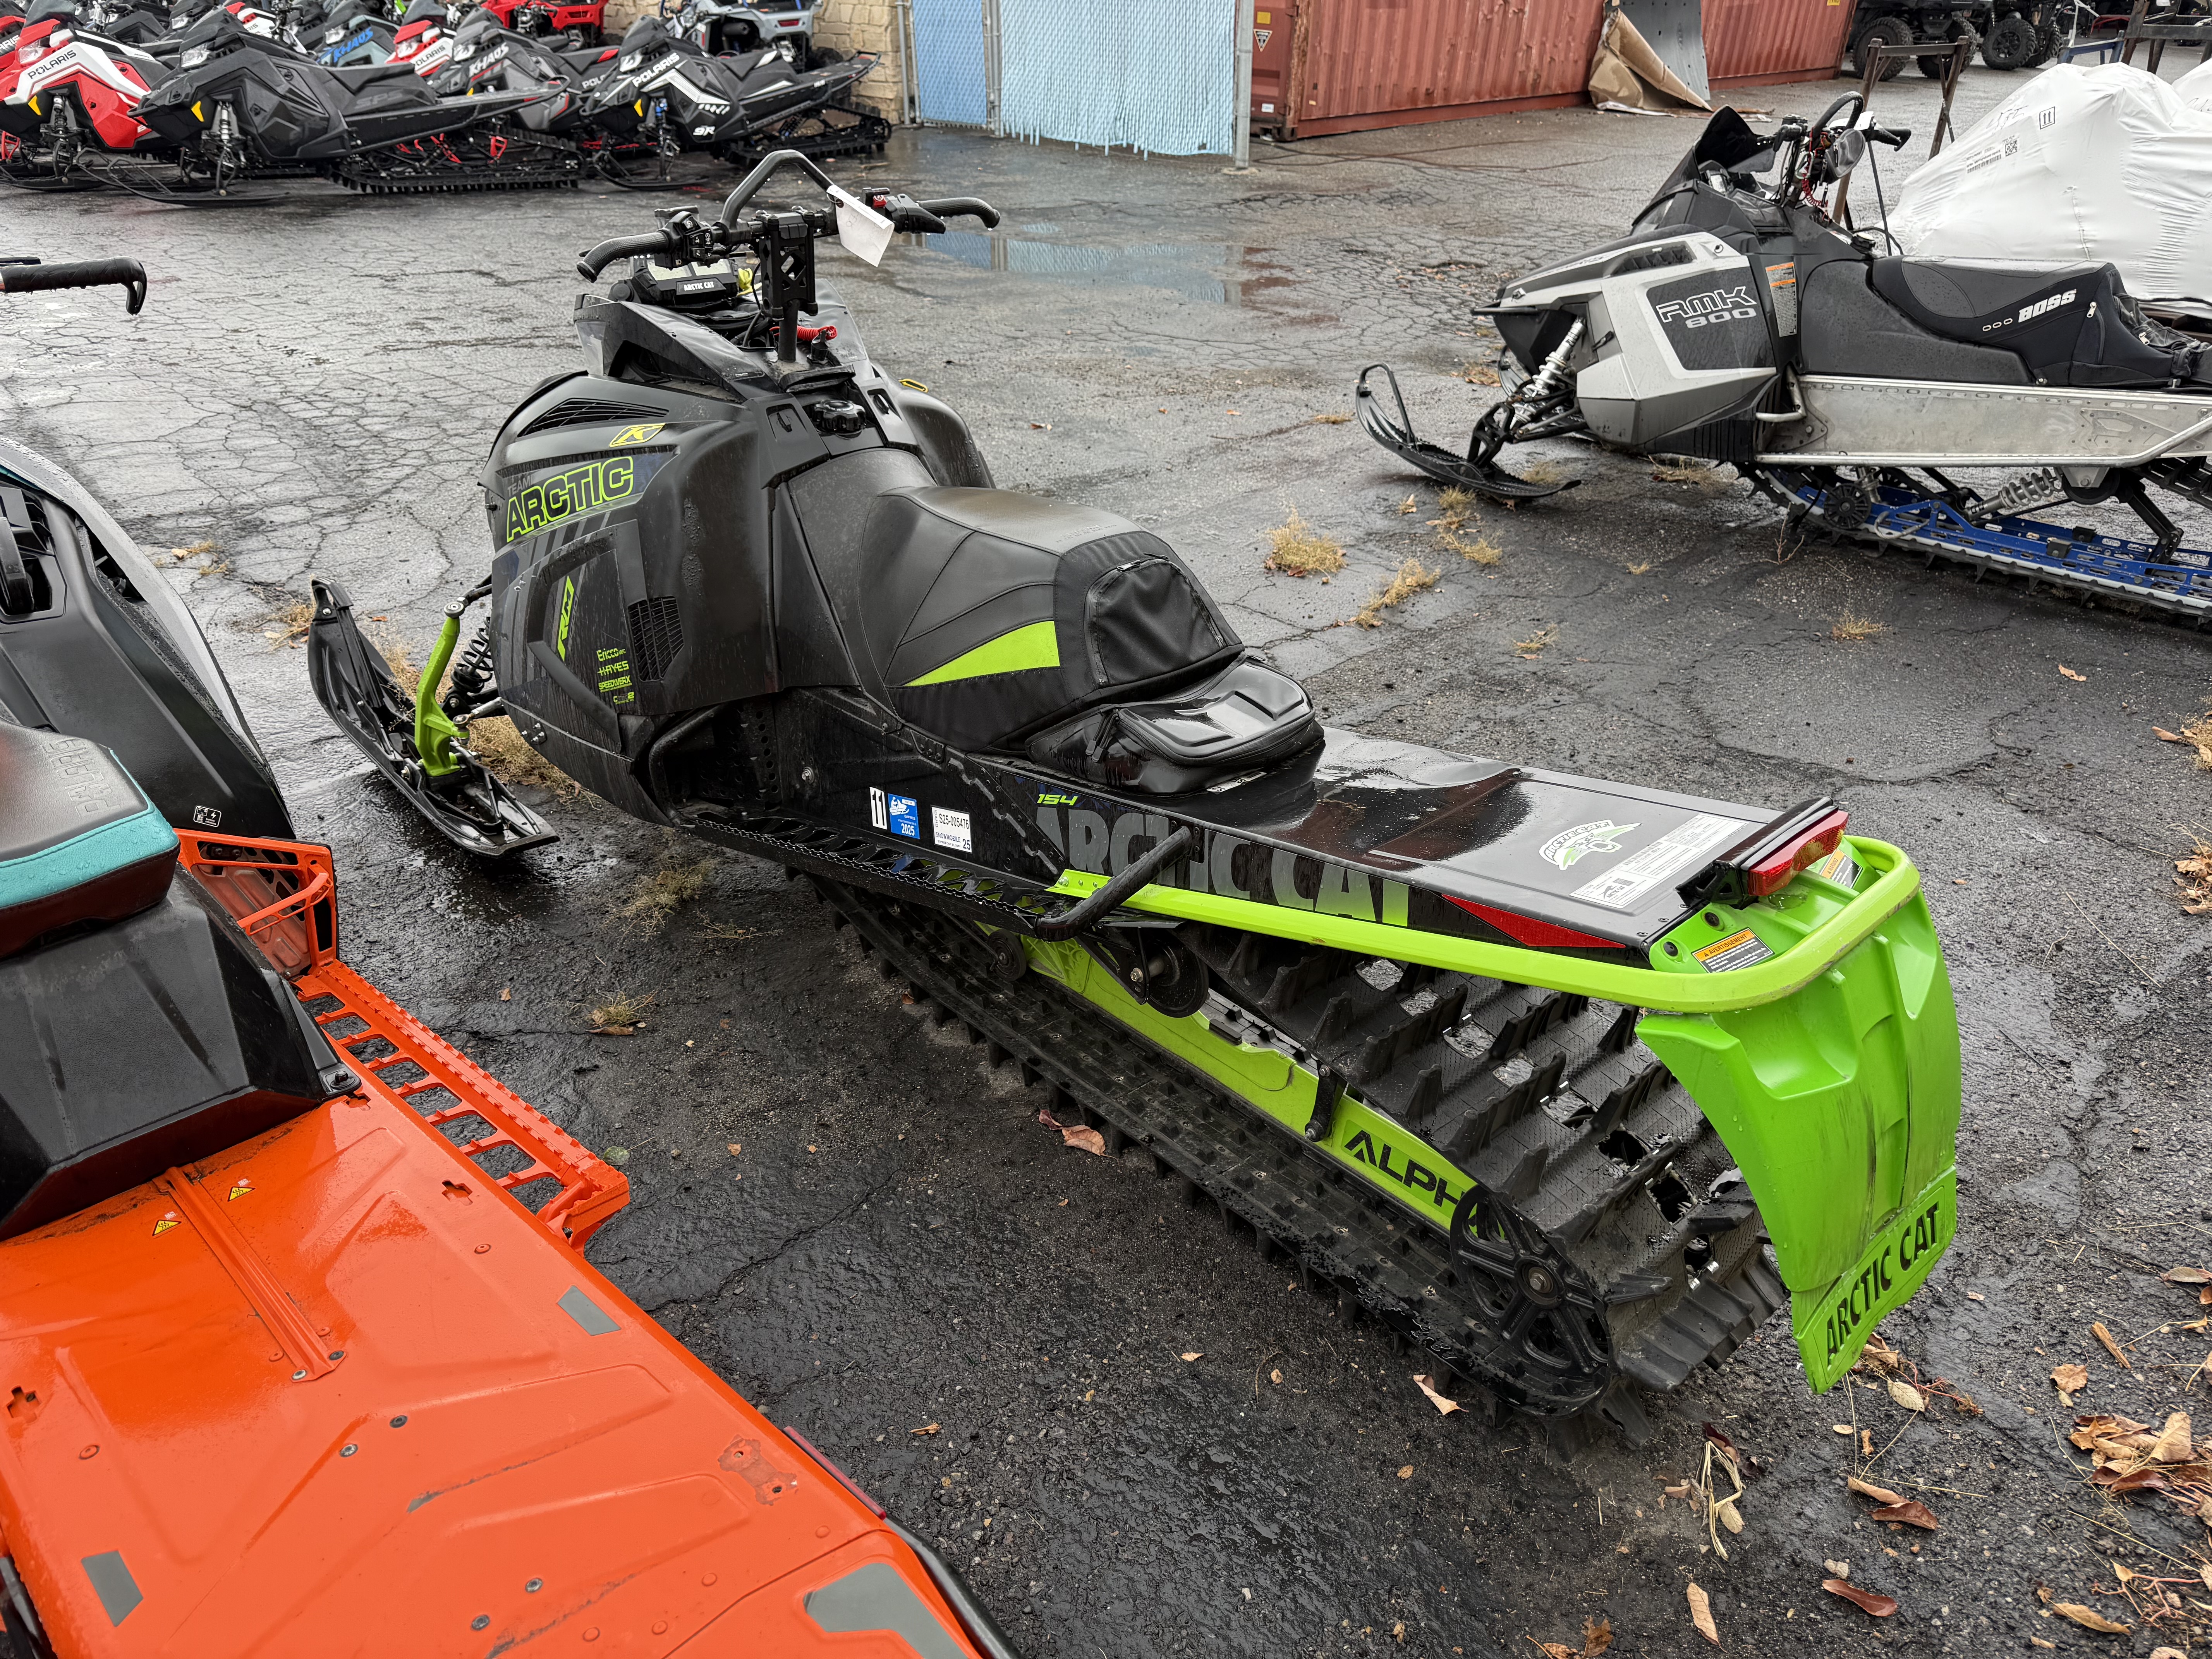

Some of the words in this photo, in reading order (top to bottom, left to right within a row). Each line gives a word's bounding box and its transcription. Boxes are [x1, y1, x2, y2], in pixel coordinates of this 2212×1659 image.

[333, 26, 373, 58] KHAOS
[416, 45, 445, 66] OLARIS
[27, 50, 76, 79] POLARIS
[469, 42, 509, 77] KHAOS
[632, 52, 680, 87] POLARIS
[1656, 286, 1757, 323] RMK
[1685, 308, 1757, 328] 800
[2018, 289, 2076, 323] BOSS
[507, 475, 531, 497] TEAM
[507, 456, 633, 542] ARCTIC
[597, 660, 629, 676] HAYES
[41, 737, 121, 817] POLARIS
[872, 790, 885, 826] 11
[1037, 794, 1078, 805] 154
[901, 823, 915, 836] 2025
[939, 813, 969, 830] S25-005476
[936, 832, 961, 843] SNOWMOBILE
[963, 838, 970, 850] 25
[1271, 847, 1408, 927] CAT
[1709, 934, 1747, 955] AVERTISSEMENT
[1345, 1130, 1466, 1207] ALPH
[1827, 1244, 1892, 1372] ARCTIC
[1899, 1200, 1940, 1272] CAT
